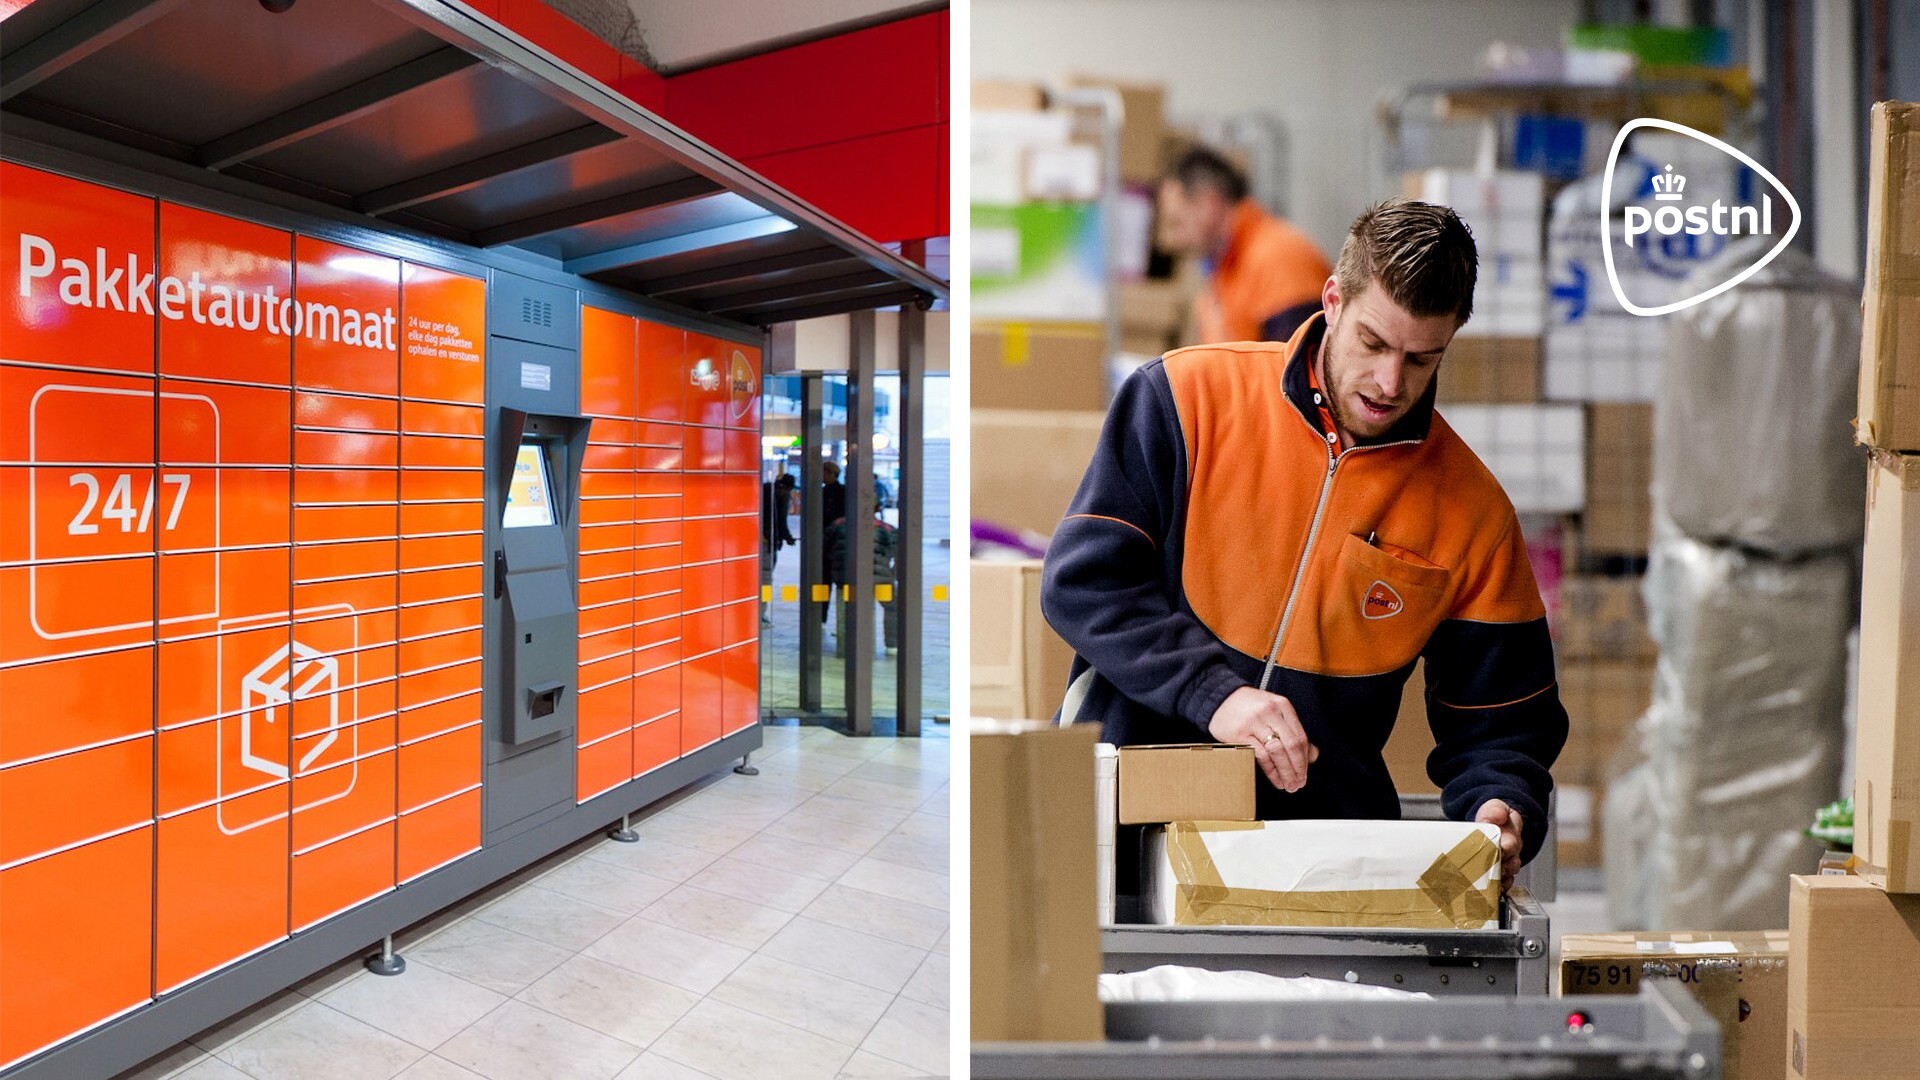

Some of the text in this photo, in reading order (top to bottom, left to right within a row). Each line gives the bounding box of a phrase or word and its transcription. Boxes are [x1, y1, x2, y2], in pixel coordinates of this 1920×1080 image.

[20, 233, 396, 351] Pakketautomaat
[408, 316, 417, 328] 24
[419, 320, 431, 329] uur
[433, 322, 444, 332] per
[408, 330, 473, 349] elke dag pakketten
[408, 344, 479, 362] ophalen en versturen
[67, 473, 191, 535] 24/7
[1368, 597, 1398, 610] postnl
[1574, 965, 1600, 986] 75
[1607, 965, 1631, 985] 91
